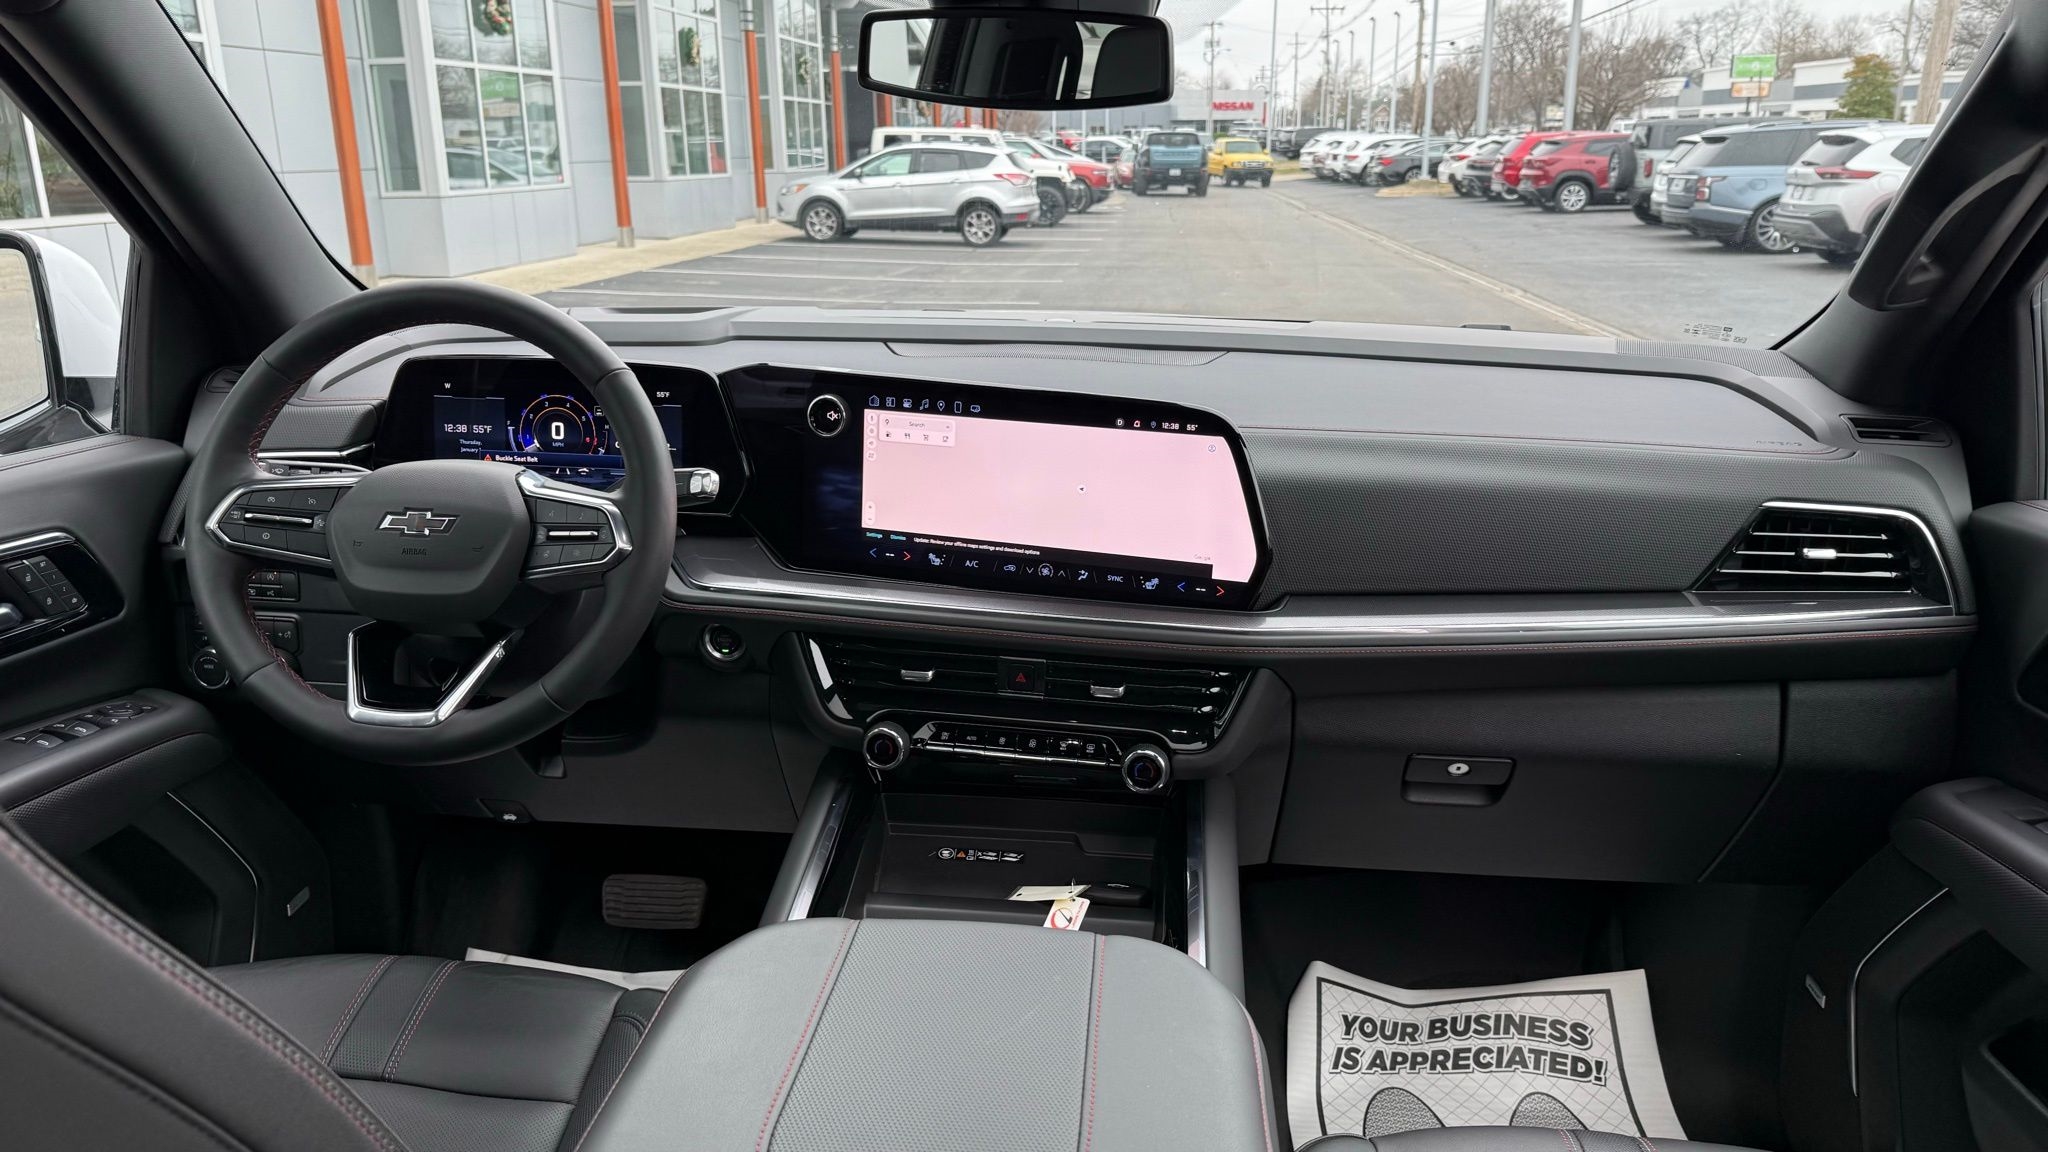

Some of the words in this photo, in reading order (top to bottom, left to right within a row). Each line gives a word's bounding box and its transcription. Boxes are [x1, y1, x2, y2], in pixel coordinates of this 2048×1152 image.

[1212, 102, 1254, 111] NISSAN
[444, 424, 468, 433] 12:38
[472, 425, 492, 434] 55°F
[551, 421, 565, 440] 0
[1162, 422, 1179, 430] 12:38
[965, 560, 979, 568] A/C
[1107, 574, 1124, 582] SYNC
[1341, 1013, 1421, 1043] YOUR
[1426, 1012, 1595, 1047] BUSINESS
[1331, 1045, 1364, 1071] IS
[1365, 1045, 1607, 1083] APPRECIATED!
